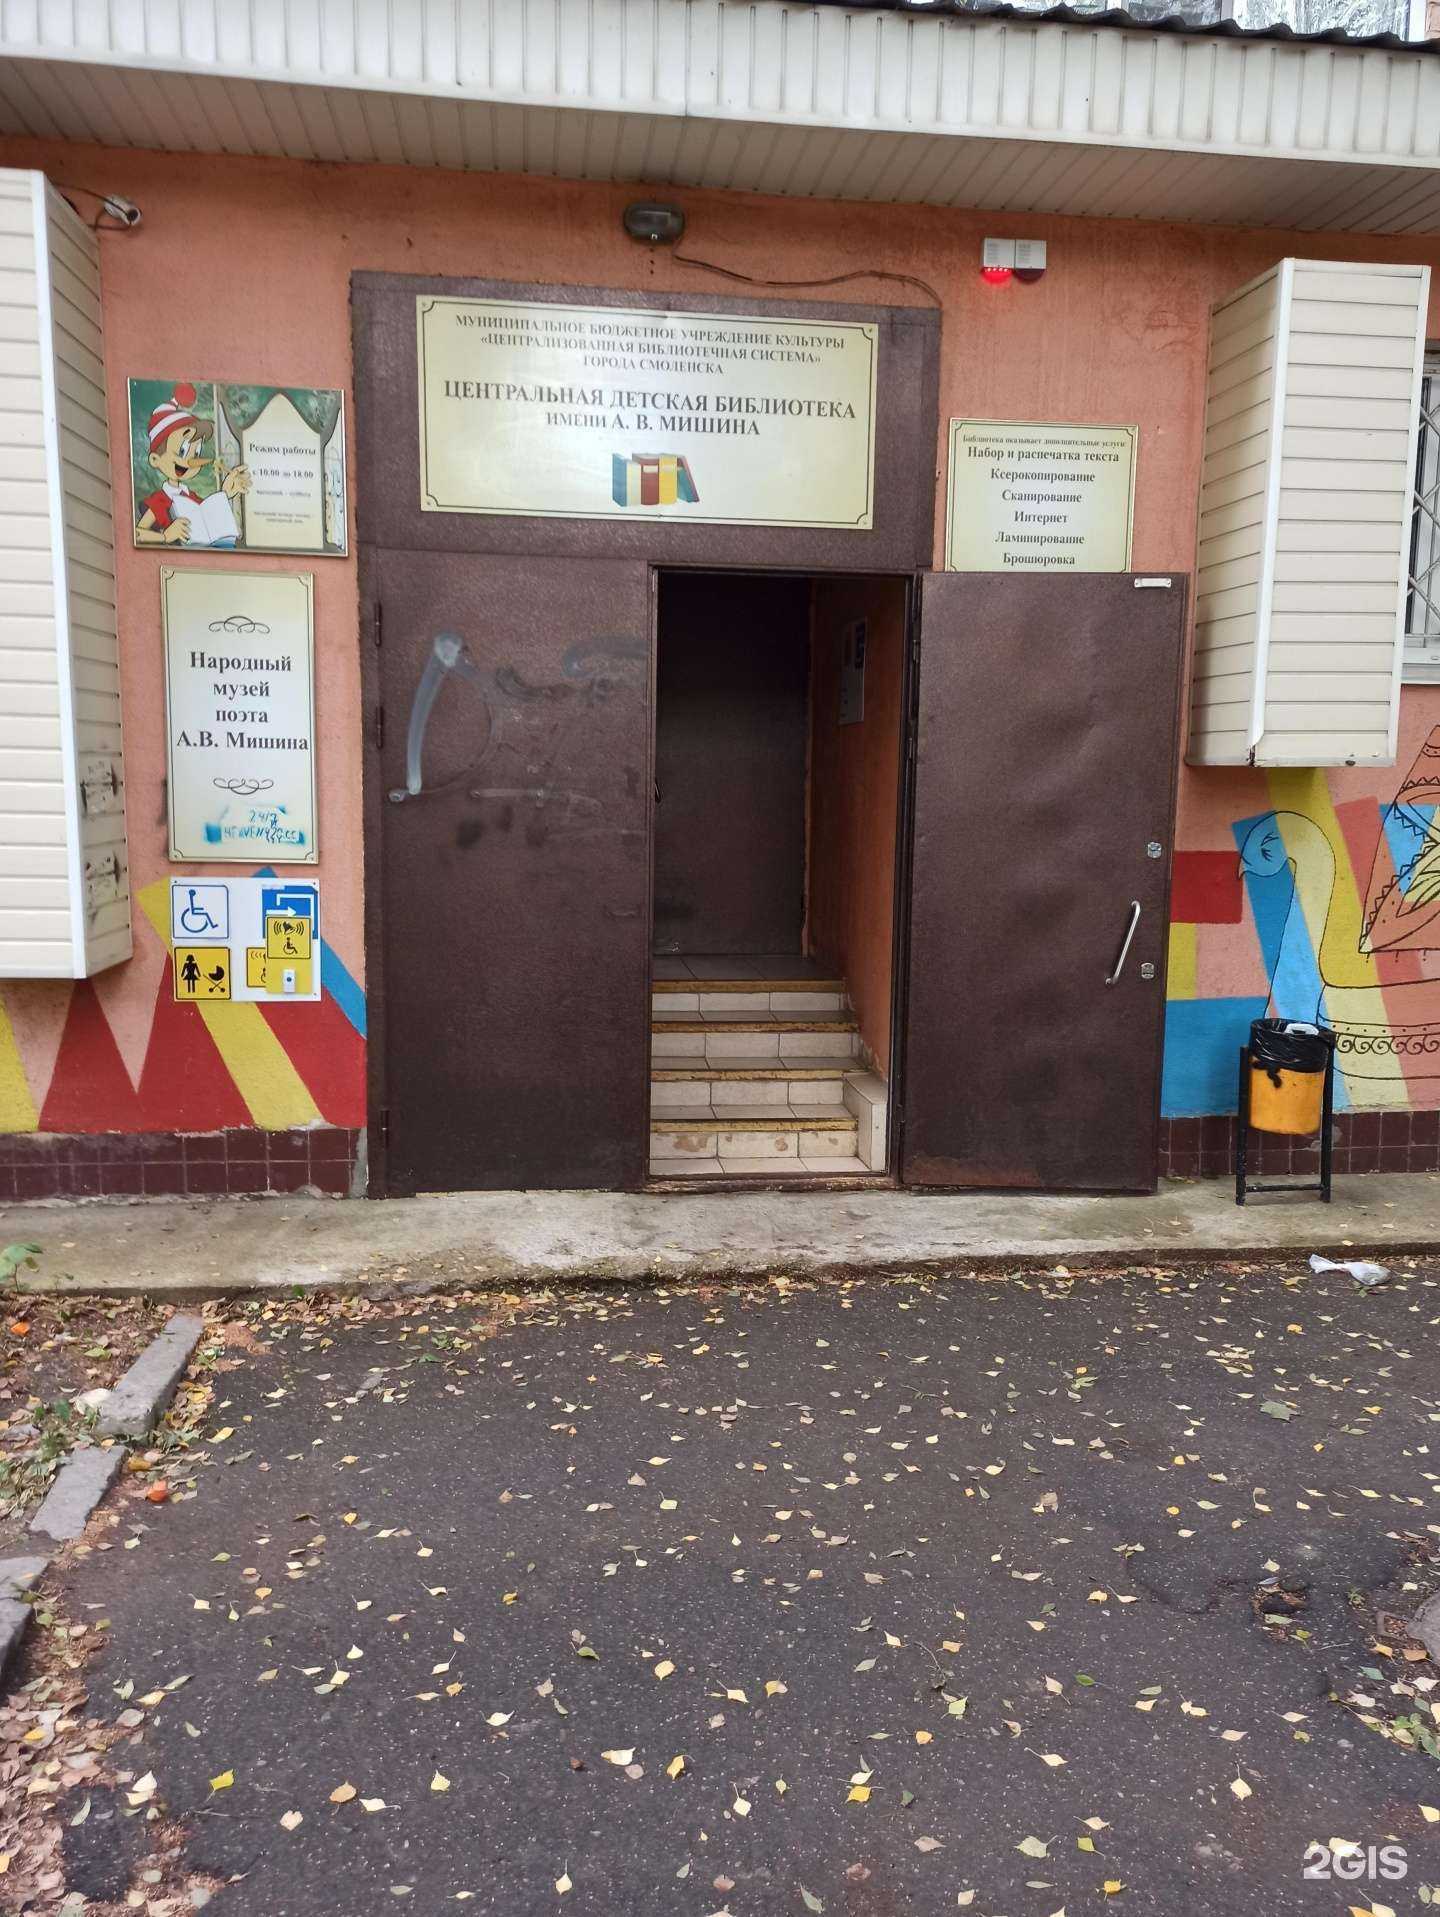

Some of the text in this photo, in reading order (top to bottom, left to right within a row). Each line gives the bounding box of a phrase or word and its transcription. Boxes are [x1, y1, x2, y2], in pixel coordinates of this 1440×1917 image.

[456, 315, 846, 349] МУНИЦИПАЛЬНОЕ БЮДЖЕТНОЕ УЧРЕЖДЕНИЕ КУЛЬТУРЫ
[481, 333, 822, 363] «ЦЕНТРАЛИЗОВАННАЯ БИБЛИОТЕЧНАЯ СИСТЕМА»
[584, 355, 724, 374] ГОРОДА СМОЛЕНСКА
[444, 380, 856, 419] ЦЕНТРАЛЬНАЯ ДЕТСКАЯ БИБЛИОТЕКА
[546, 411, 760, 435] ИМЕНИ А. В. МИШИНА
[249, 443, 316, 455] Режим работы
[968, 446, 1120, 462] Набор и распечатка текста
[990, 468, 1096, 484] Ксерокопирование
[1001, 488, 1082, 503] Сканирование
[1013, 510, 1069, 526] Интернет
[994, 531, 1085, 547] Ламинирование
[1002, 552, 1076, 566] Брошюровка
[190, 651, 292, 674] Народный
[213, 681, 271, 701] музей
[215, 709, 269, 724] поэта
[176, 729, 309, 751] А.В. Мишина
